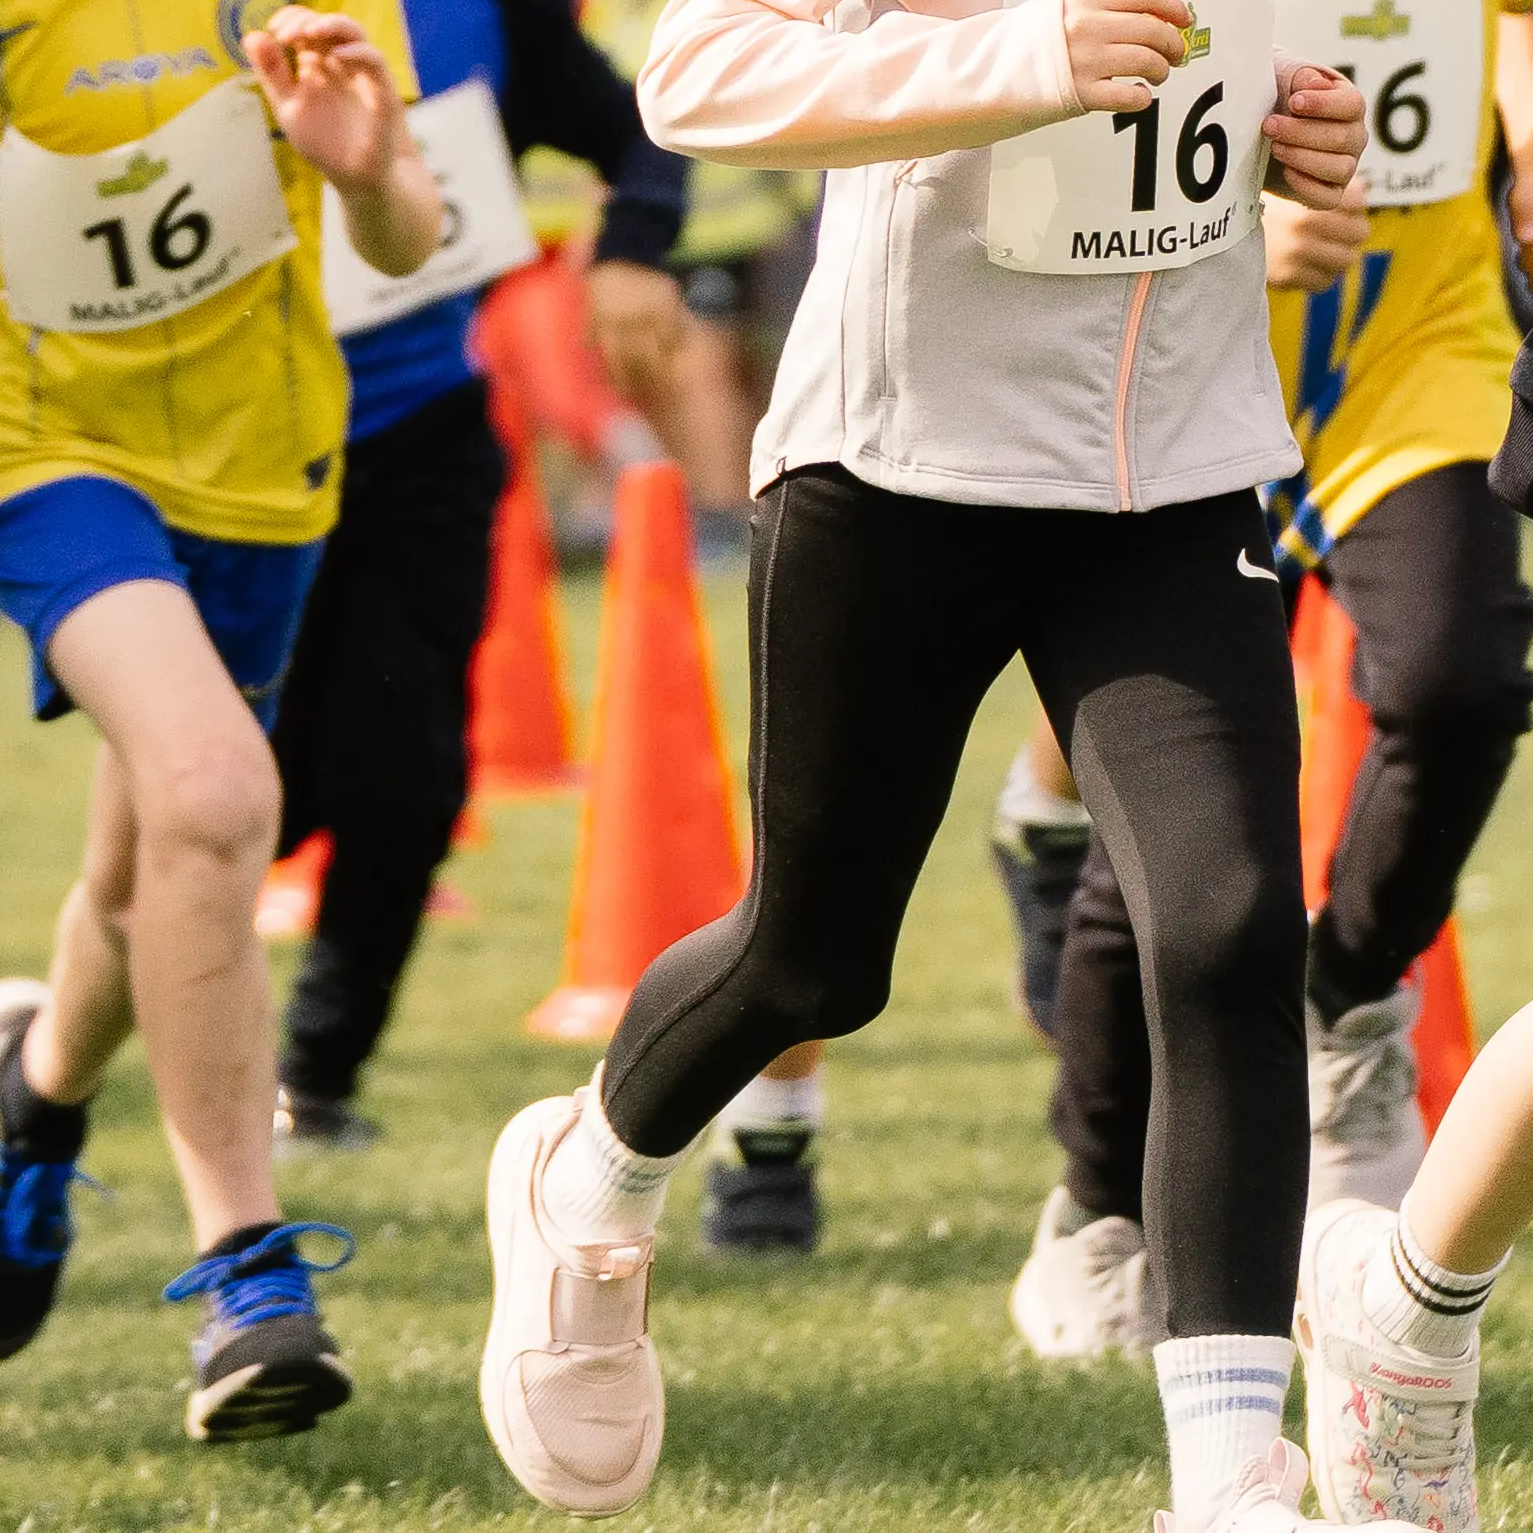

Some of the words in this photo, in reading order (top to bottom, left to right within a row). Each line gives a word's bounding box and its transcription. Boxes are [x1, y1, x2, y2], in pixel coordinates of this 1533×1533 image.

[1112, 80, 1229, 213] 16
[1333, 61, 1432, 154] 6
[82, 182, 213, 289] 16
